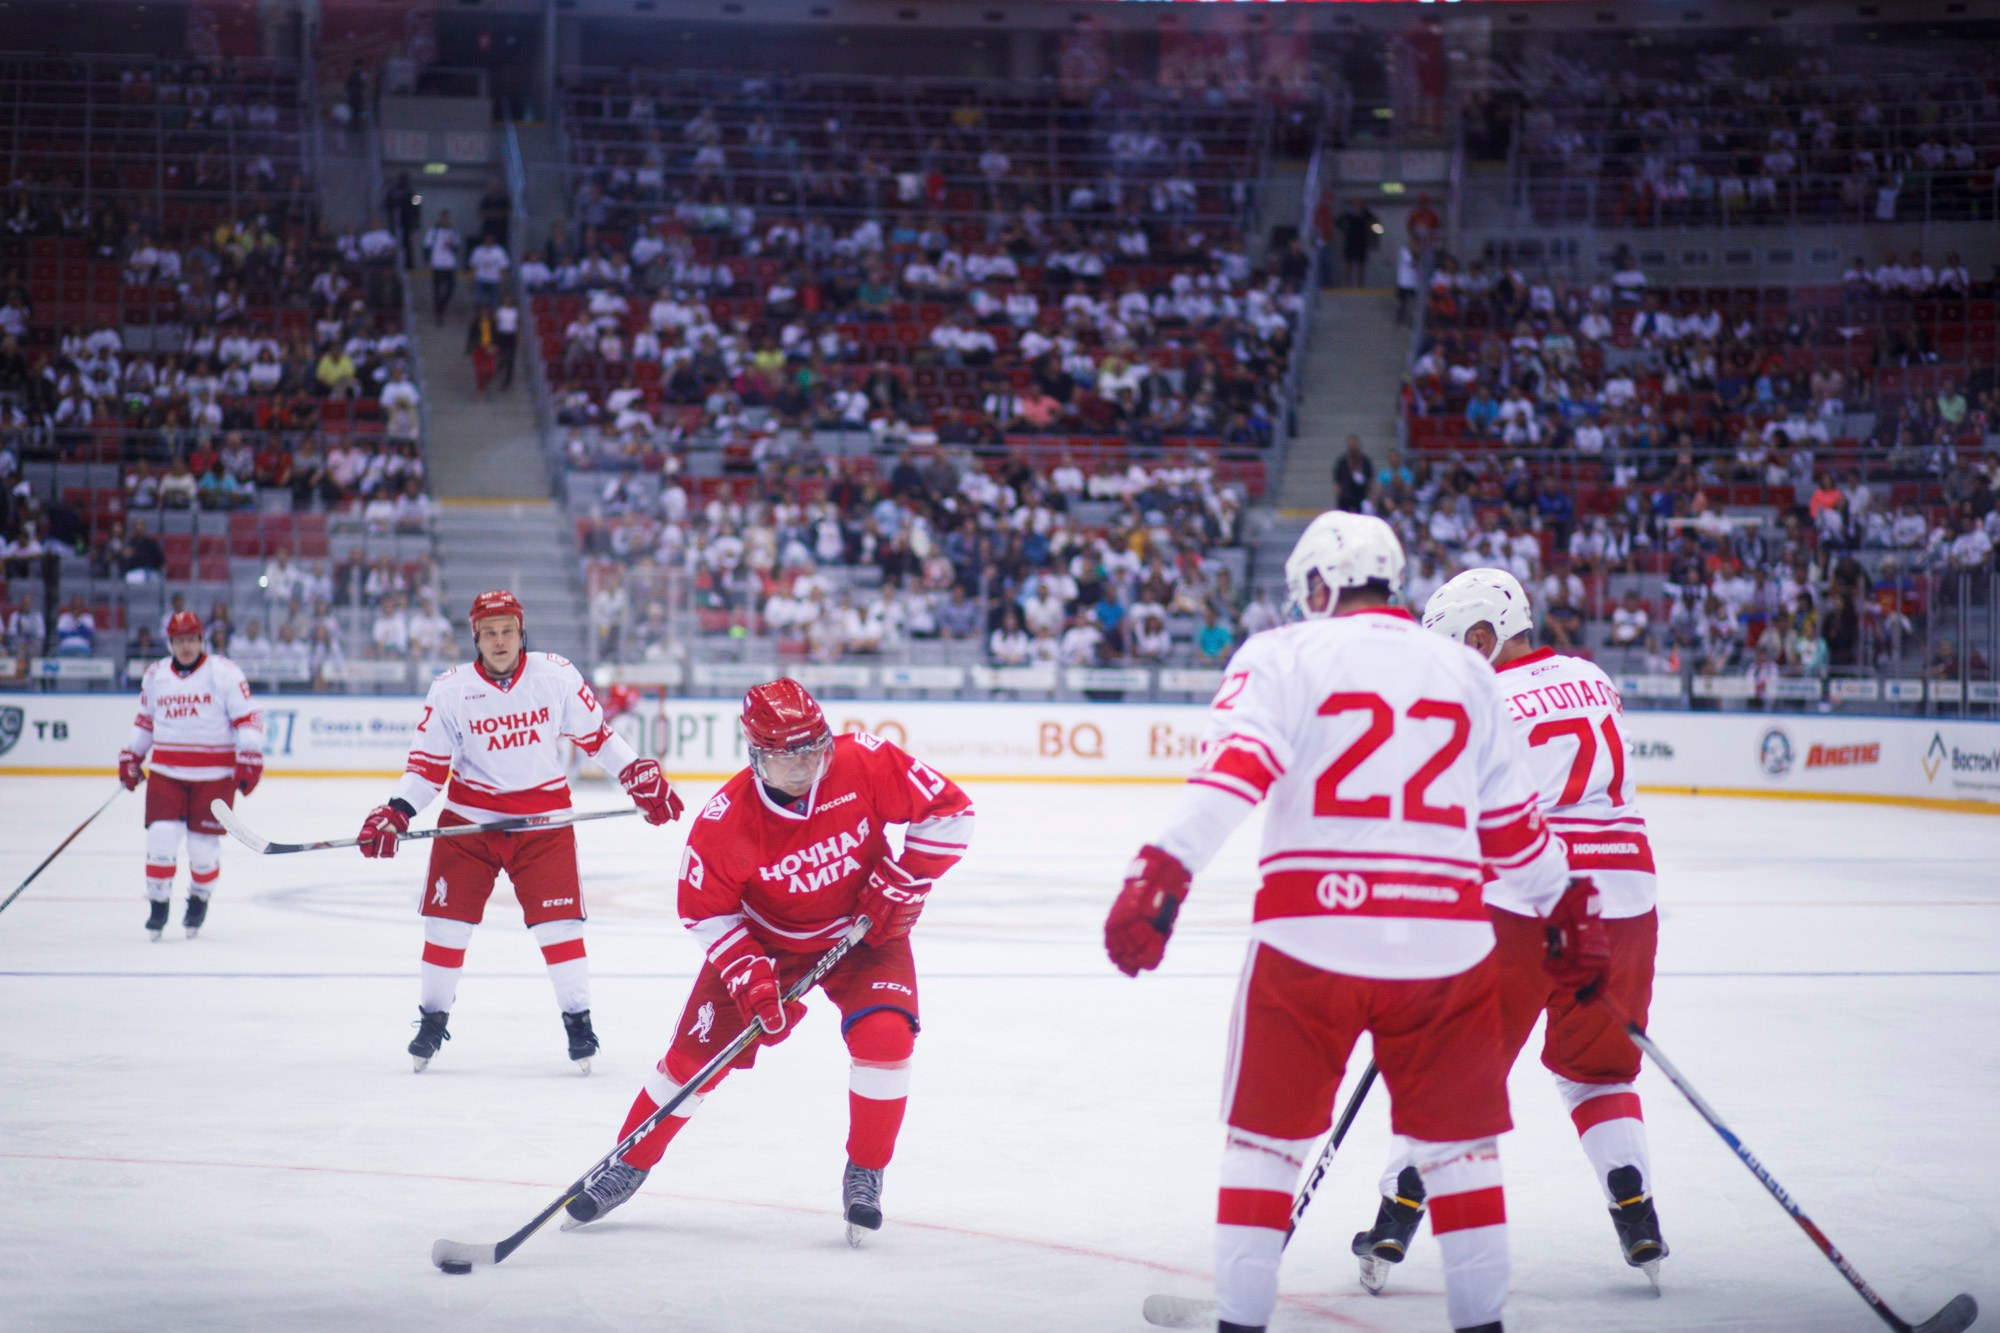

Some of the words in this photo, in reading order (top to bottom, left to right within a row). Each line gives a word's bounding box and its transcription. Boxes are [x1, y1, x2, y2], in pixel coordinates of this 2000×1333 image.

[157, 693, 211, 706] НОЧНАЯ
[165, 706, 199, 719] ЛИГА
[32, 721, 68, 740] ТВ
[469, 706, 550, 735] НОЧНАЯ
[487, 728, 541, 751] ЛИГА
[1038, 722, 1105, 757] BQ
[1314, 691, 1472, 830] 22
[1527, 716, 1624, 807] 71
[907, 759, 946, 802] 13
[814, 792, 857, 814] РОССИЯ
[759, 817, 870, 882] НОЧНАЯ
[788, 856, 862, 893] ЛИГА
[868, 871, 929, 905] CCM
[542, 897, 574, 908] CCM
[814, 946, 849, 981] CCM
[871, 981, 912, 996] CCM
